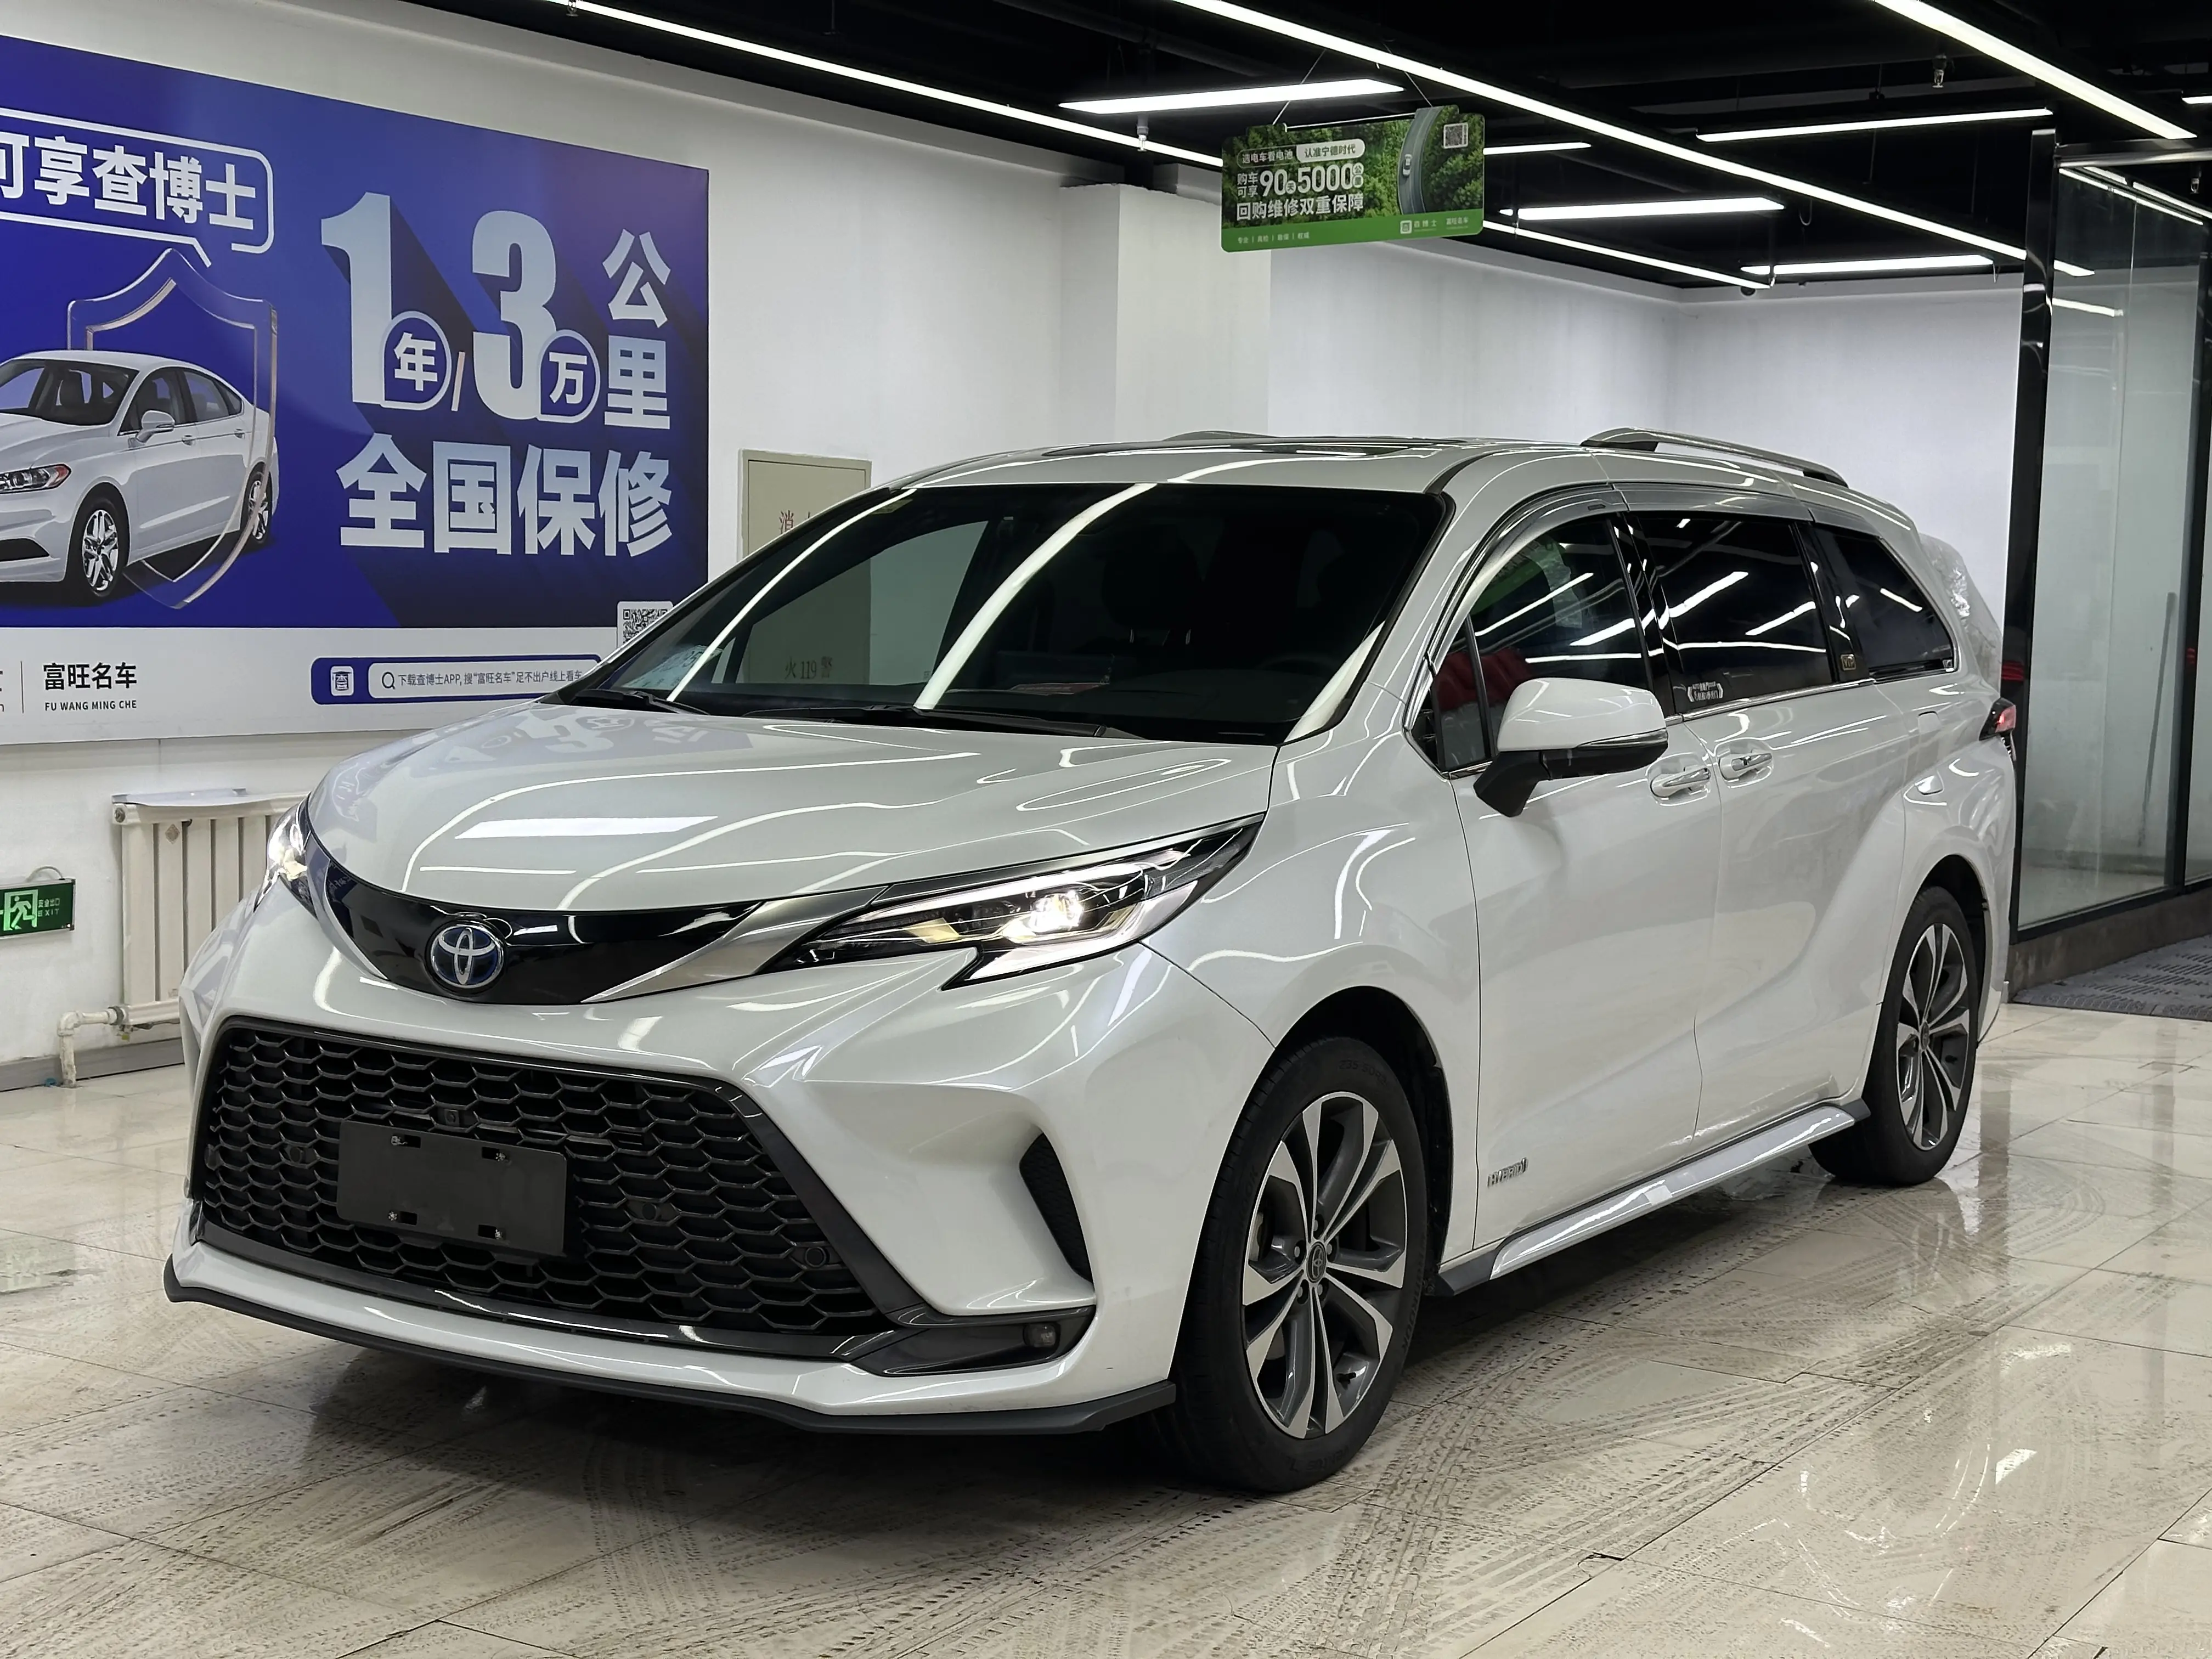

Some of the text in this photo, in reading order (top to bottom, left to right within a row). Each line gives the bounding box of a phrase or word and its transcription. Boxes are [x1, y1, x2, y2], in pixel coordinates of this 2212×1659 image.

[1305, 143, 1356, 158] 认准宁德时代
[1237, 172, 1259, 185] 购车
[1237, 185, 1258, 198] 可享
[1237, 193, 1363, 221] 回购维修双重保障
[603, 228, 672, 430] 公里
[336, 432, 673, 557] 全国保修
[43, 662, 137, 691] 富旺名车
[45, 700, 137, 711] FU WANG MING CHE
[38, 898, 60, 908] 安全出口
[38, 909, 59, 917] EXIT
[1487, 1158, 1528, 1187] HYBRID
